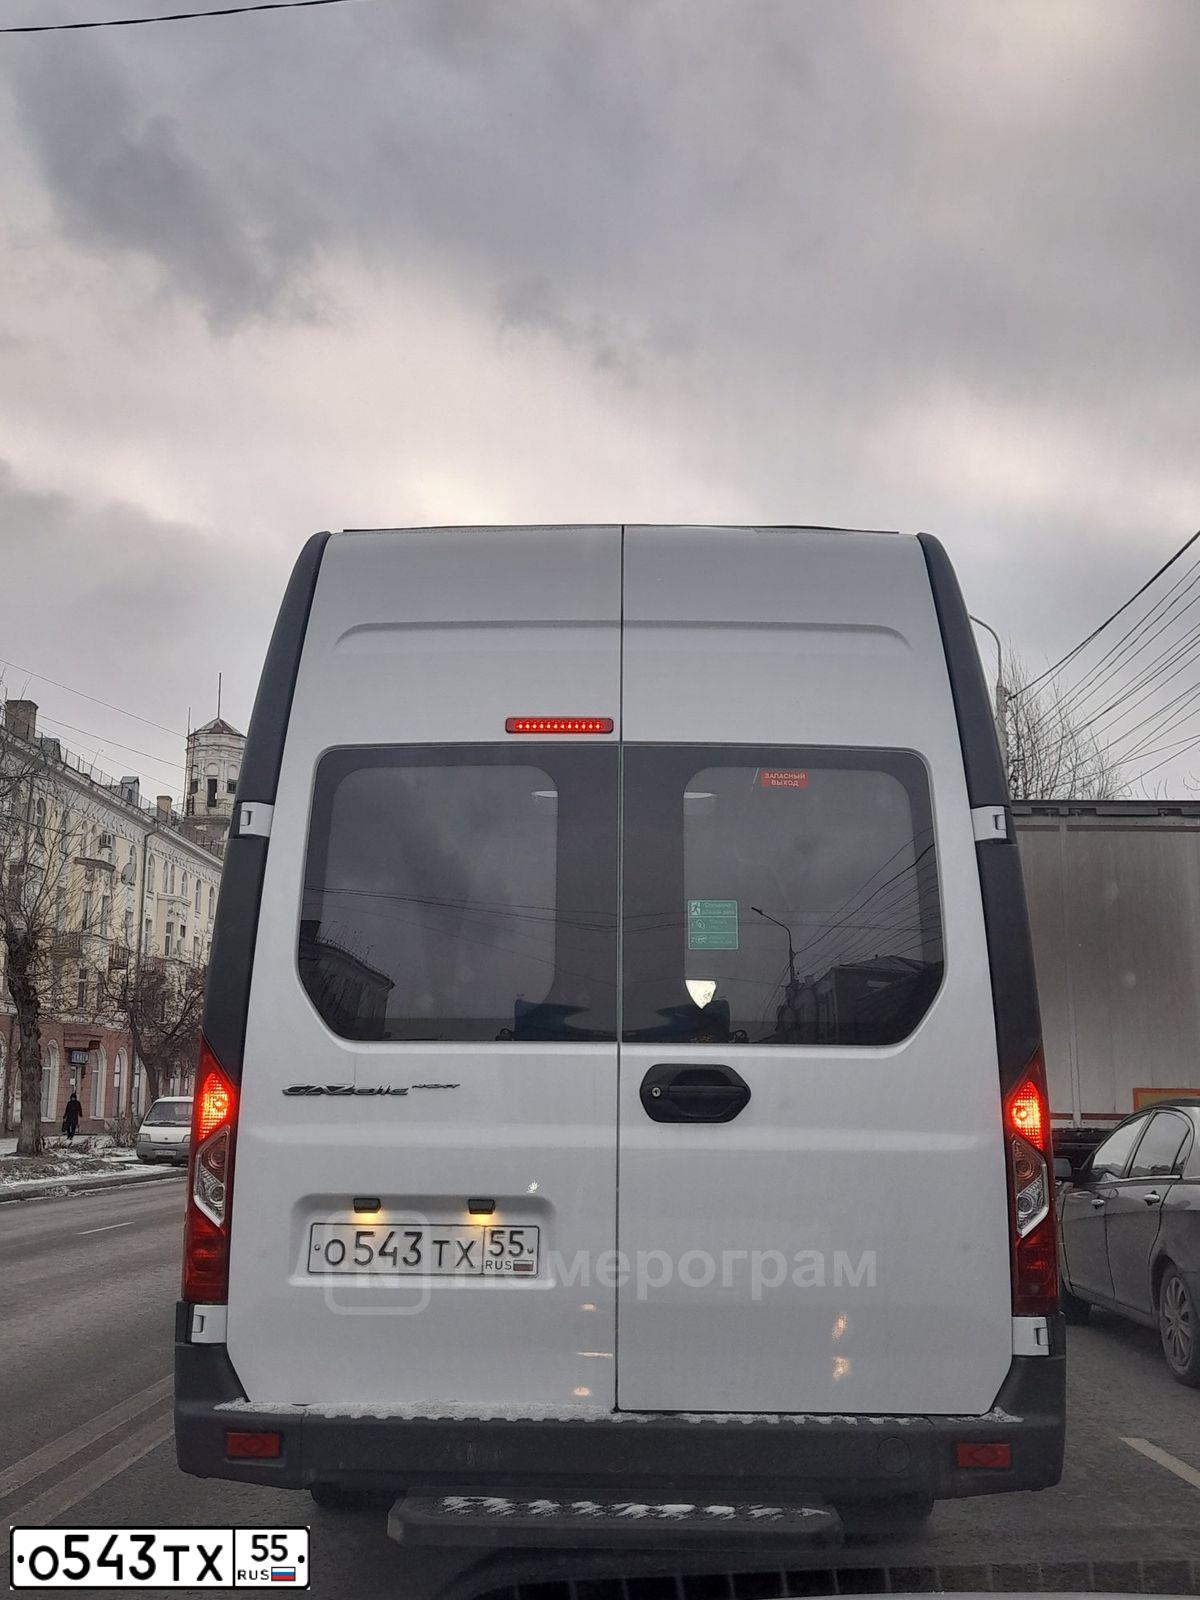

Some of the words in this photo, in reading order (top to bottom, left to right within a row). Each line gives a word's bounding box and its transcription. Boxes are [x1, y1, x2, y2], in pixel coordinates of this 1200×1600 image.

[764, 772, 806, 780] ЗАПАСНЫЙ
[771, 780, 800, 788] ВЫХОД
[488, 1230, 524, 1257] 55
[485, 1259, 512, 1271] RUS
